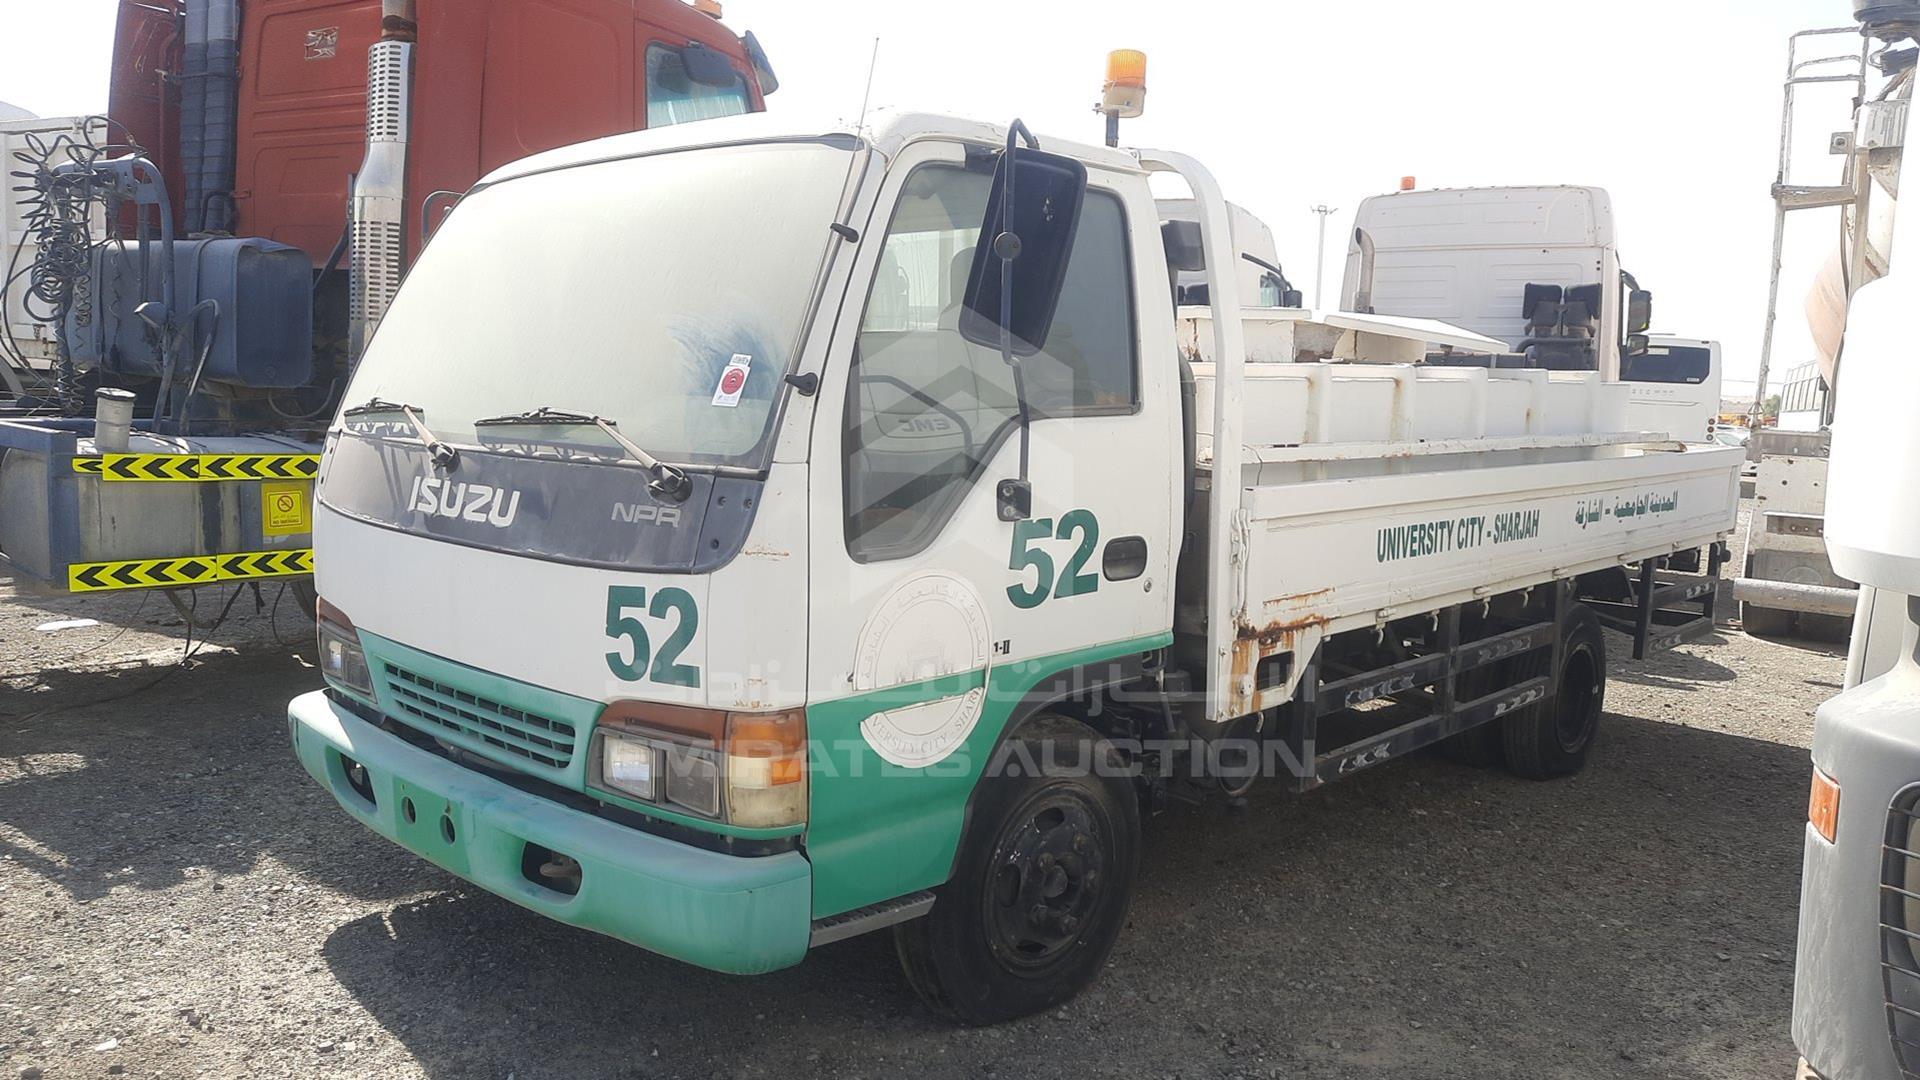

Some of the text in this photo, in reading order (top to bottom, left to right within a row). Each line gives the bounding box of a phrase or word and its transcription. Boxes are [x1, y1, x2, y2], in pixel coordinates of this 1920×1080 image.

[407, 475, 521, 529] ISUZU
[611, 502, 682, 528] NPR
[1006, 508, 1099, 609] 52
[1377, 519, 1455, 563] UNIVERSITY
[1457, 515, 1486, 550] CITY
[1493, 509, 1540, 544] SHARJAH
[605, 585, 701, 689] 52
